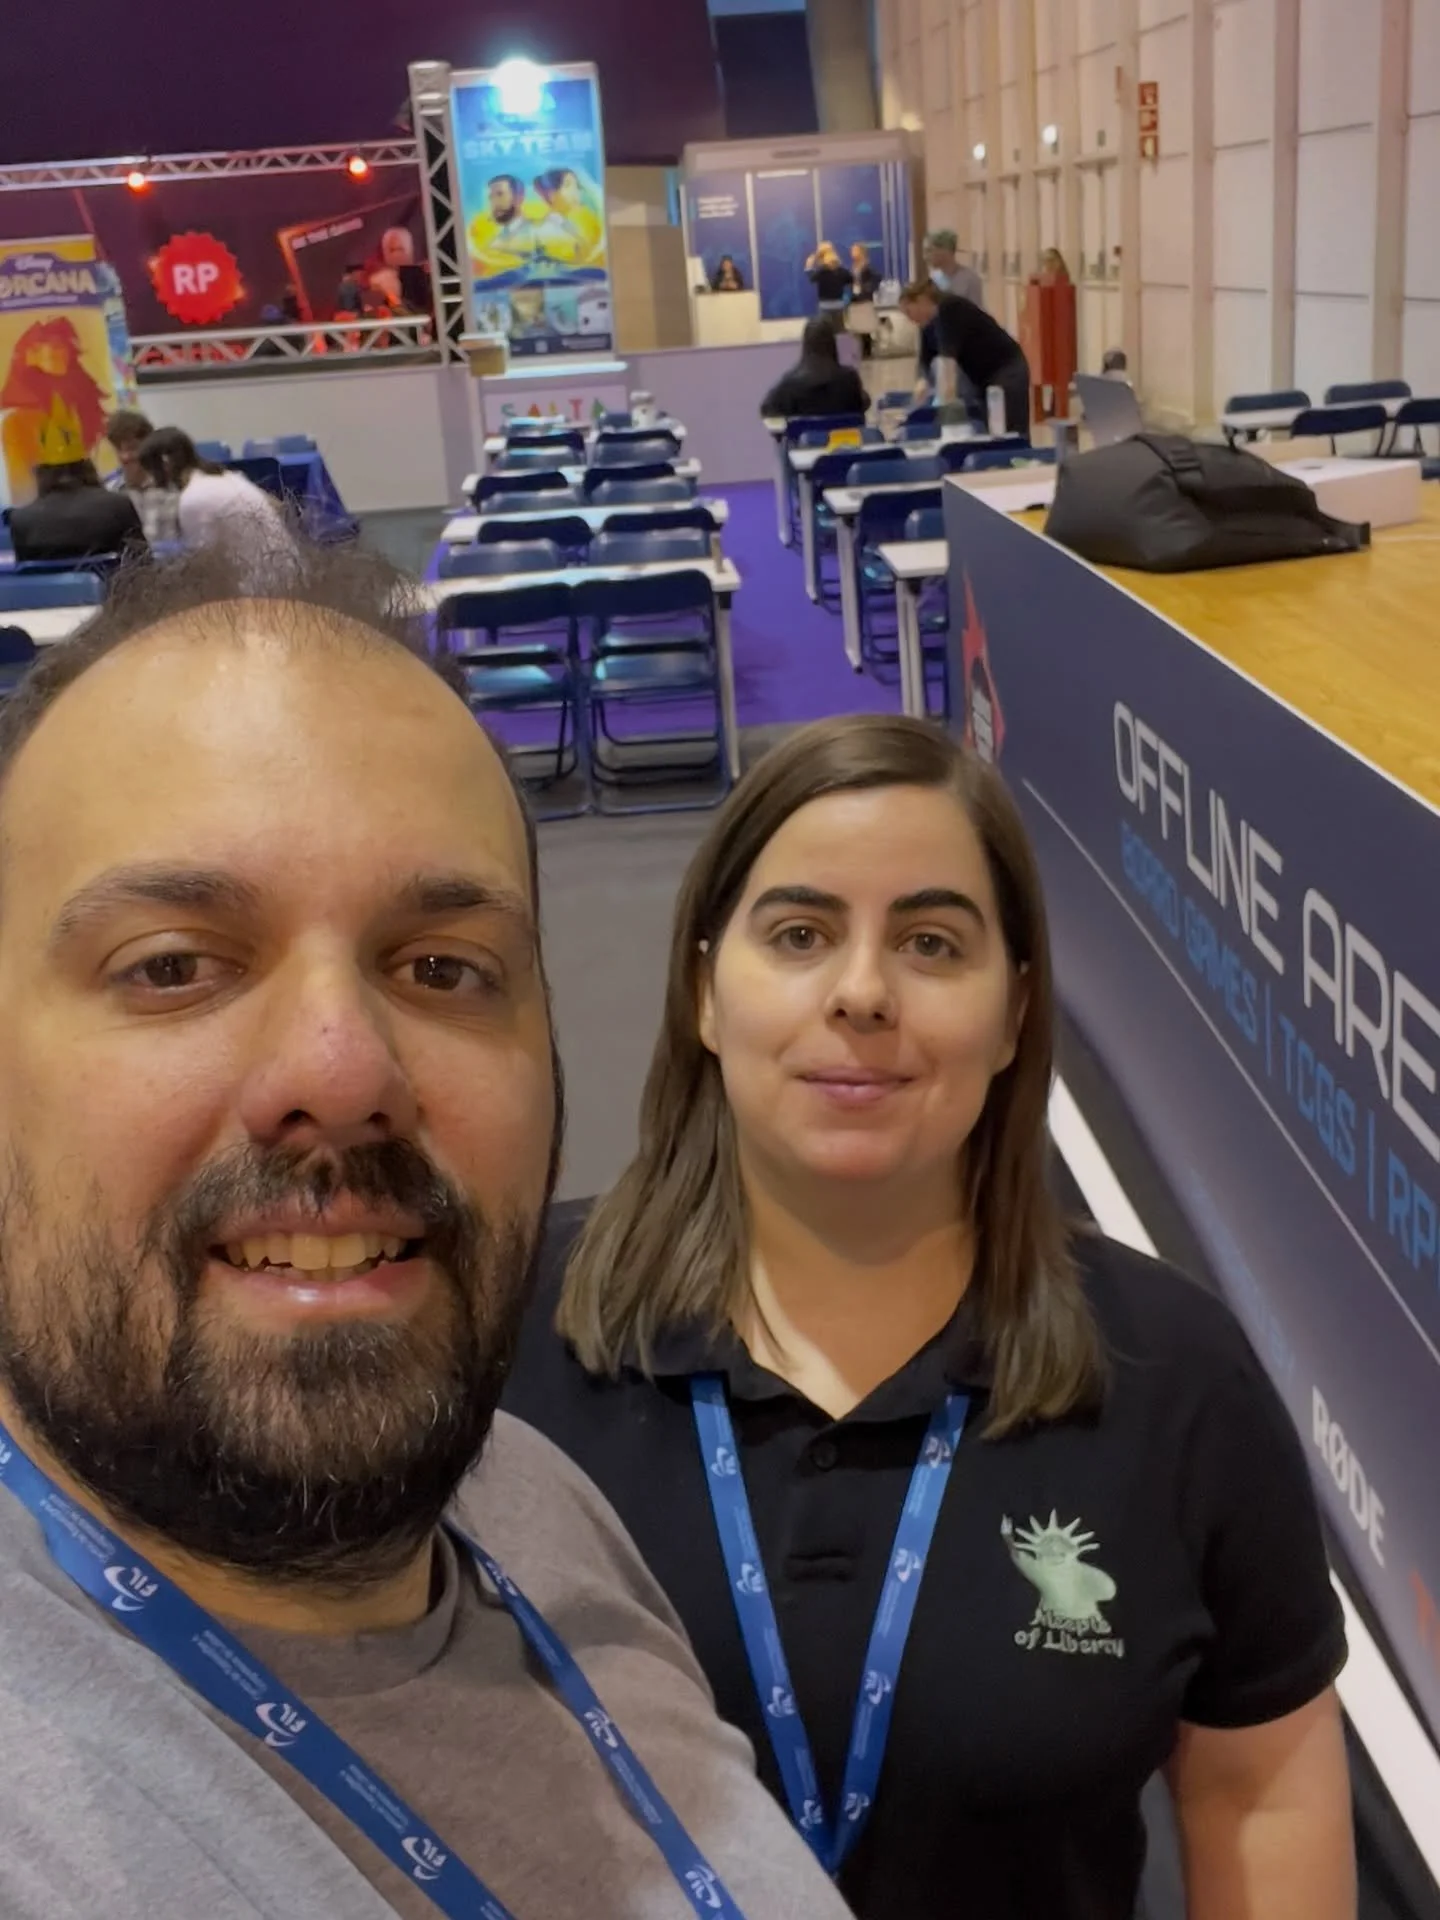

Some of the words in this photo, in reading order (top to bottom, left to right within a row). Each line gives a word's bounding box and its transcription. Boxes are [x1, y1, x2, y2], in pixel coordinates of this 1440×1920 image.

[172, 262, 220, 295] RP
[1113, 700, 1284, 975] OFFLINE
[1120, 818, 1180, 940] BOARD
[1184, 895, 1257, 1044] GAMES
[1387, 1147, 1440, 1292] RP
[1312, 1384, 1385, 1568] RØDE
[128, 1567, 159, 1598] FIL
[1014, 1627, 1041, 1650] of
[1042, 1630, 1125, 1659] Liberty
[279, 1703, 307, 1733] FIL
[422, 1837, 448, 1867] FIL
